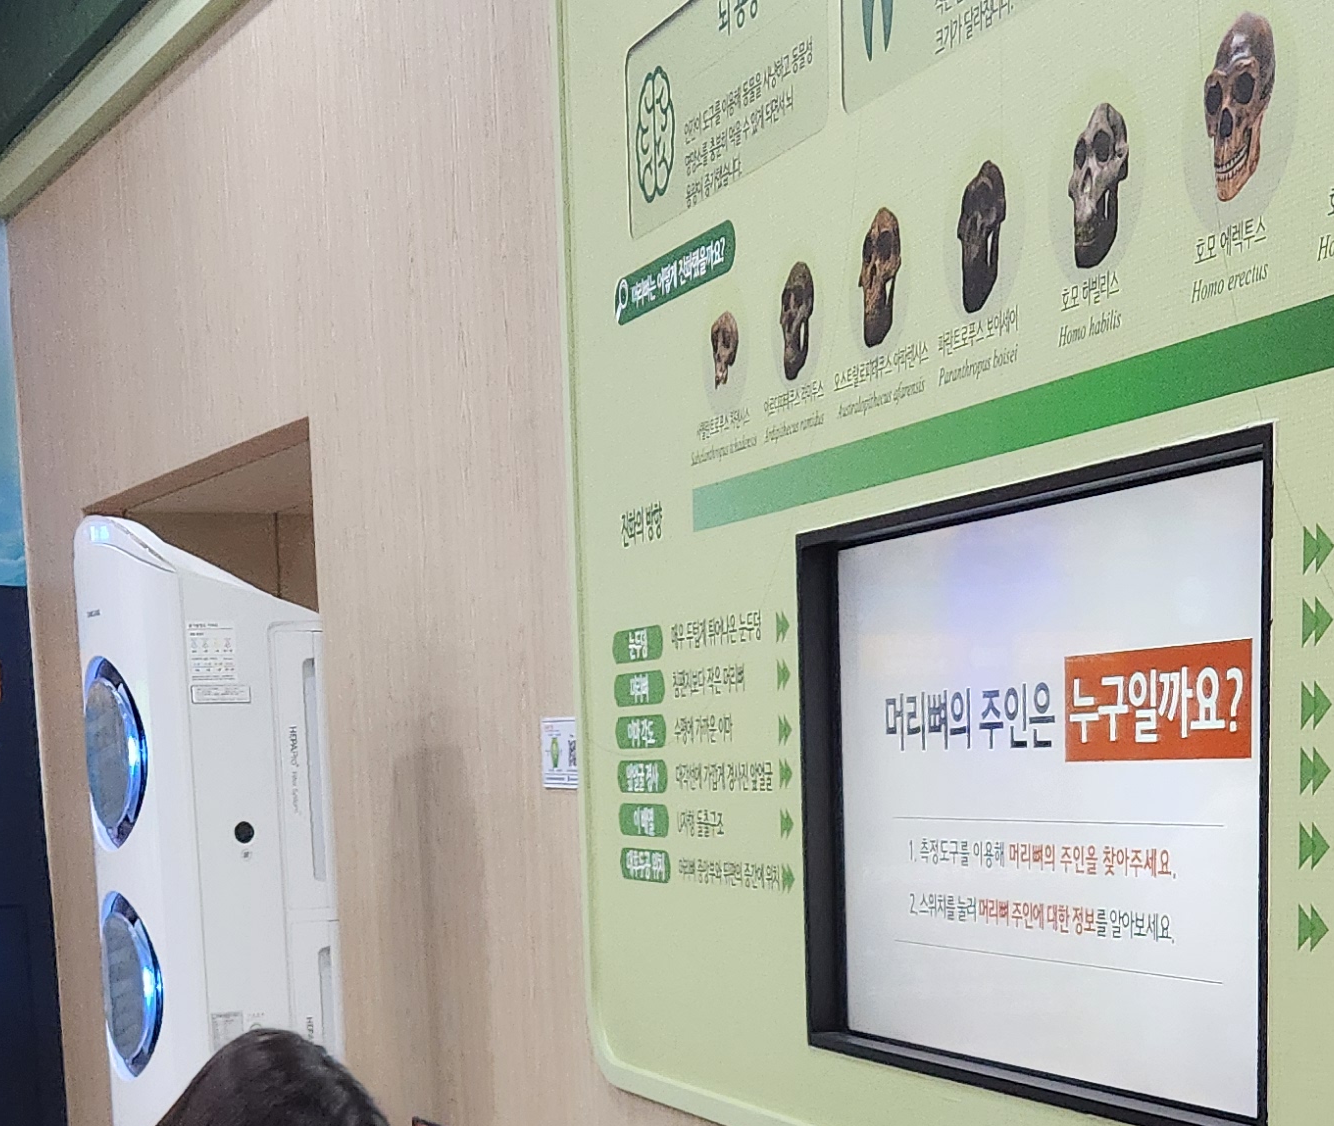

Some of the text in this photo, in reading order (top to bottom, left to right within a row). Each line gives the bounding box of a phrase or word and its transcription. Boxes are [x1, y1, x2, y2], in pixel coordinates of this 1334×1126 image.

[935, 14, 963, 54] 크기가
[1194, 214, 1268, 265] 호모 에렉투스
[1060, 269, 1120, 312] 호모 하빌리스
[1191, 259, 1269, 303] Homo erectus
[1058, 309, 1122, 347] Homo habilis
[992, 344, 1019, 369] boisei
[621, 500, 663, 548] 진화의 방향
[738, 608, 762, 641] 눈두덩
[884, 666, 1244, 751] 머리뼈의 주인은 누구일까요?
[909, 838, 1177, 880] 1. 측정도구를 이용해 머리뼈의 주인을 찾아주세요.
[909, 893, 1175, 944] 2. 스위치를 눌러 머리뼈 주인에 대한 정보를 알아보세요.
